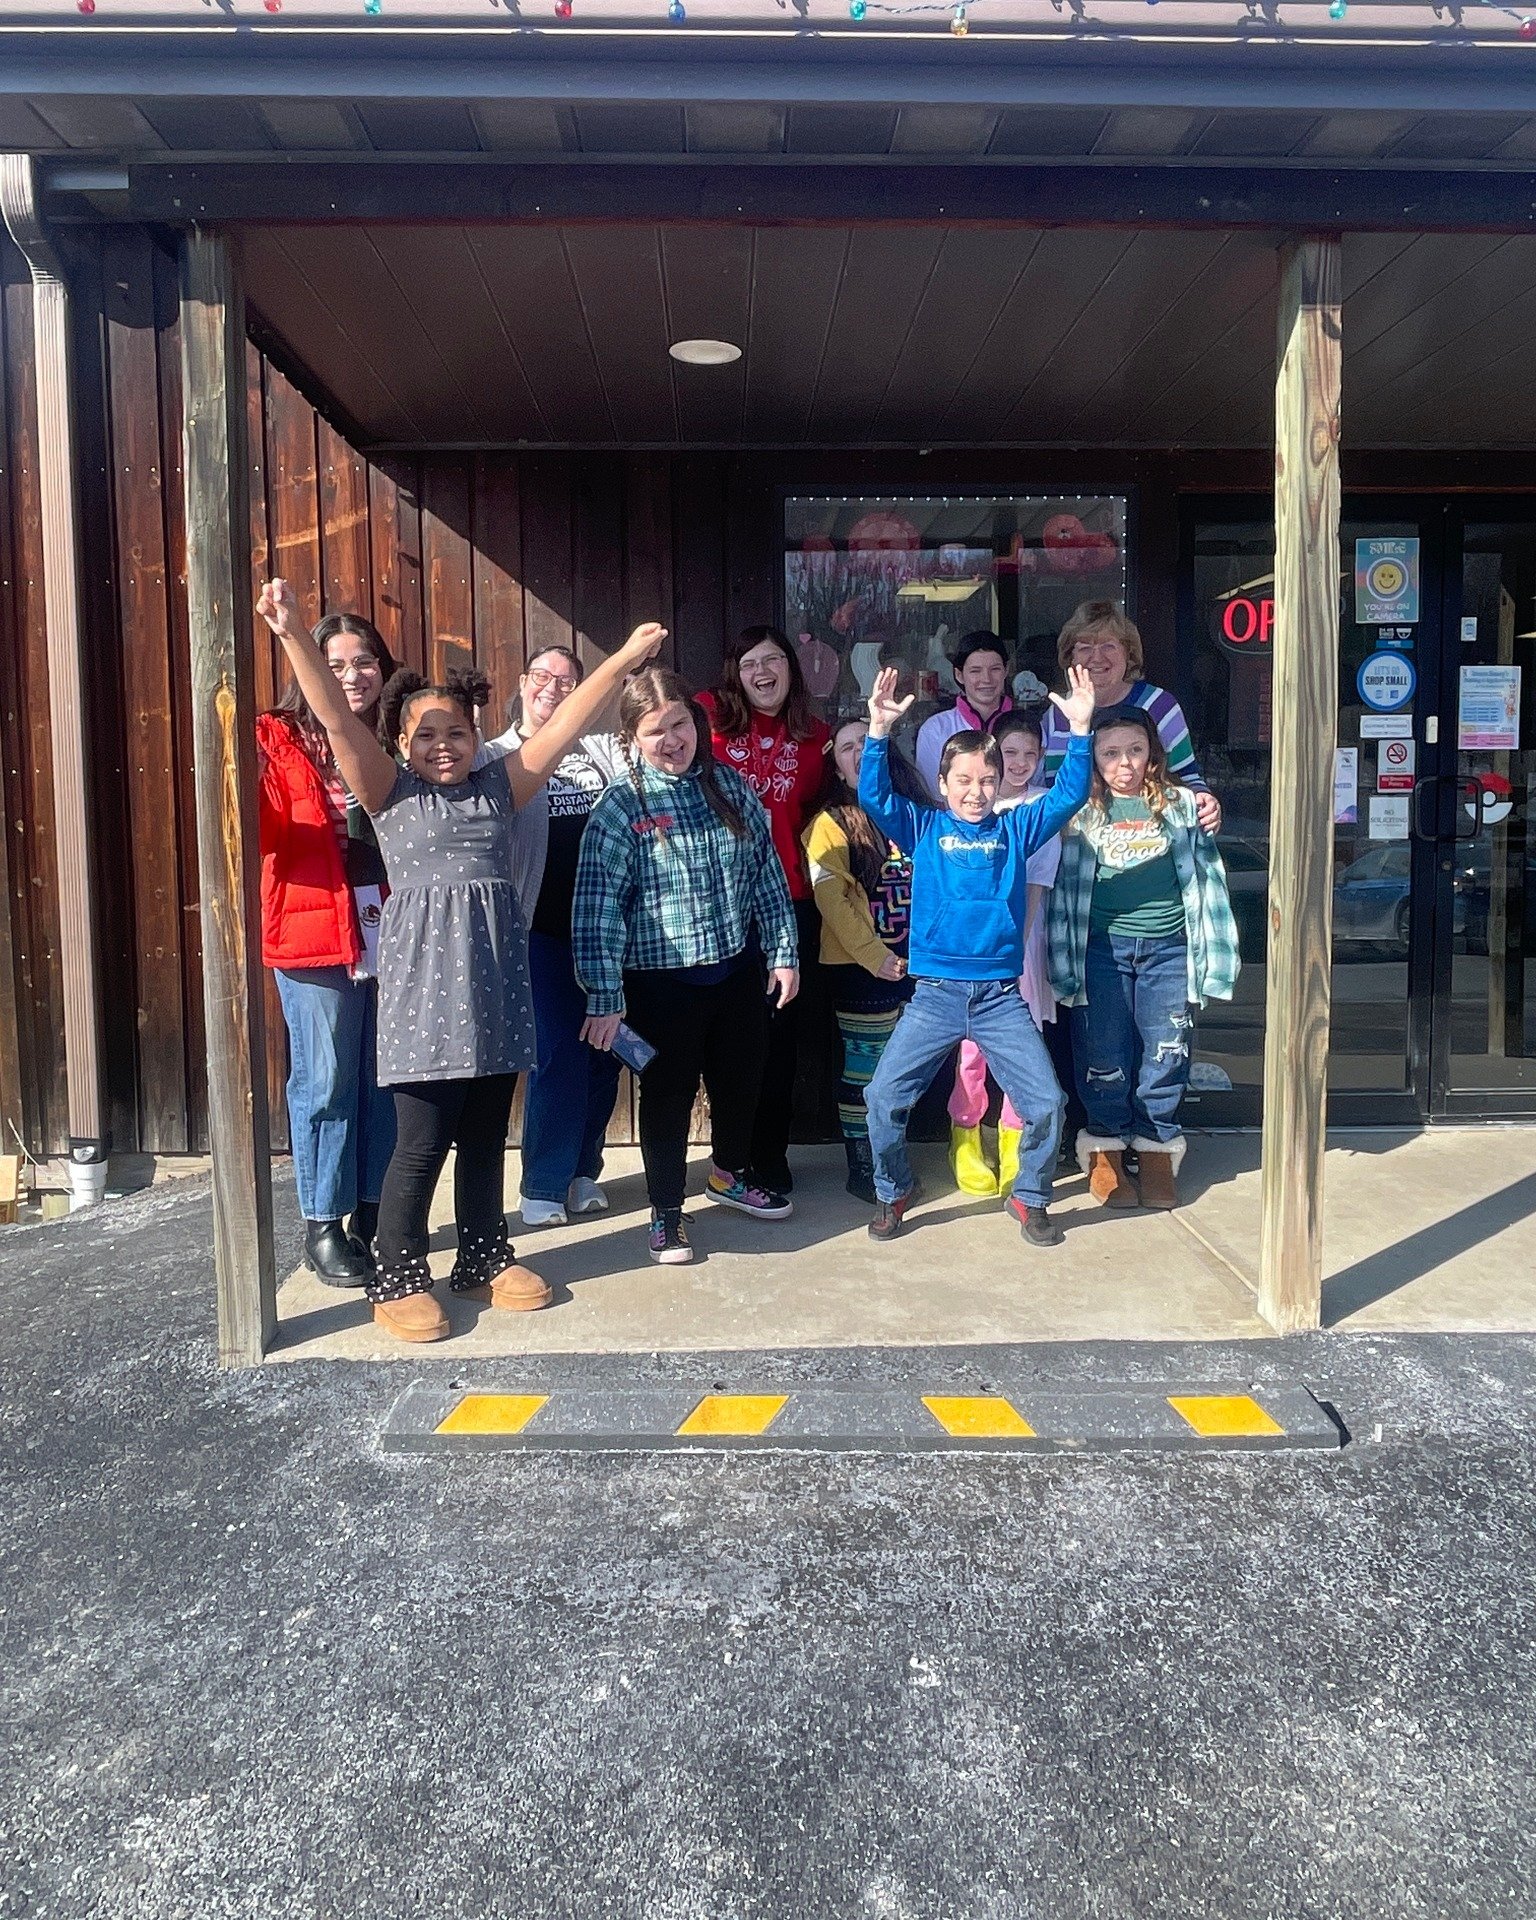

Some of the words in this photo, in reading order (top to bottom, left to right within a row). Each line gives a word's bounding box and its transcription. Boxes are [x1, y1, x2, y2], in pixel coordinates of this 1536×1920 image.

[1396, 603, 1410, 611] ON
[1223, 598, 1275, 643] OP
[1366, 612, 1406, 621] CAMERA
[1365, 676, 1384, 686] SHOP
[1385, 676, 1408, 686] SMALL
[553, 791, 602, 806] DISTANC
[548, 803, 592, 817] EARNIN
[1103, 837, 1168, 868] Good
